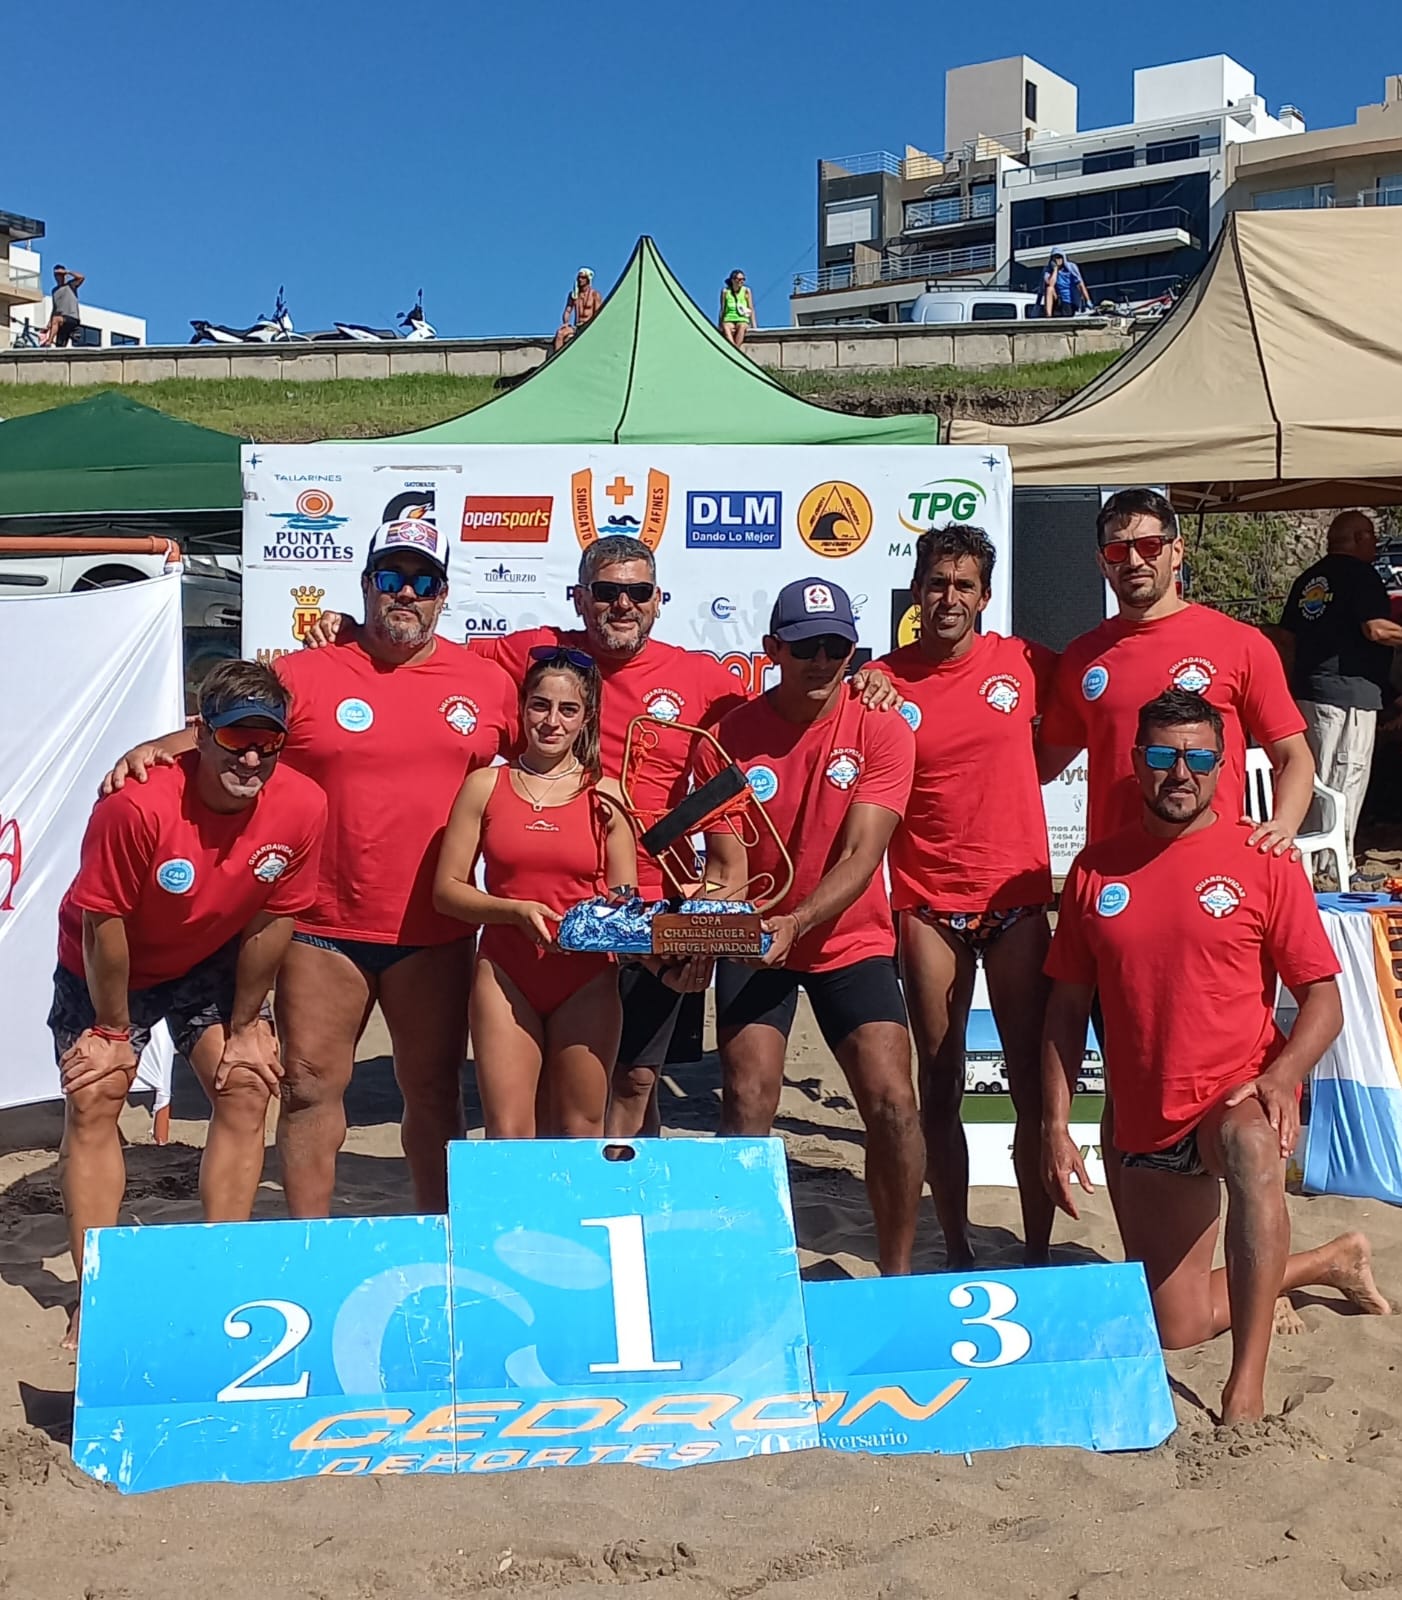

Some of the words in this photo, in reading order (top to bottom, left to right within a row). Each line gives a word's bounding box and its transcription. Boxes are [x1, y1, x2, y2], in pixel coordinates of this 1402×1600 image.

[463, 508, 550, 530] opensports
[576, 487, 593, 541] SINDICATO
[653, 487, 665, 524] AFINES
[692, 496, 776, 525] DLM
[908, 491, 978, 521] TPG
[275, 531, 336, 545] PUNTA
[692, 531, 726, 541] Dando
[728, 531, 743, 541] Lo
[744, 531, 775, 543] Mejor
[263, 545, 354, 559] MOGOTES
[1195, 875, 1247, 898] GUARDAVIDAS
[663, 928, 746, 938] CHALLENGUER
[690, 915, 722, 925] COPA
[663, 942, 707, 953] MIGUEL
[710, 942, 761, 953] NARDONE
[579, 1214, 683, 1373] 1
[949, 1280, 1032, 1368] 3
[217, 1299, 312, 1403] 2
[289, 1377, 971, 1451] CEDRON
[318, 1440, 723, 1475] DEPORTES
